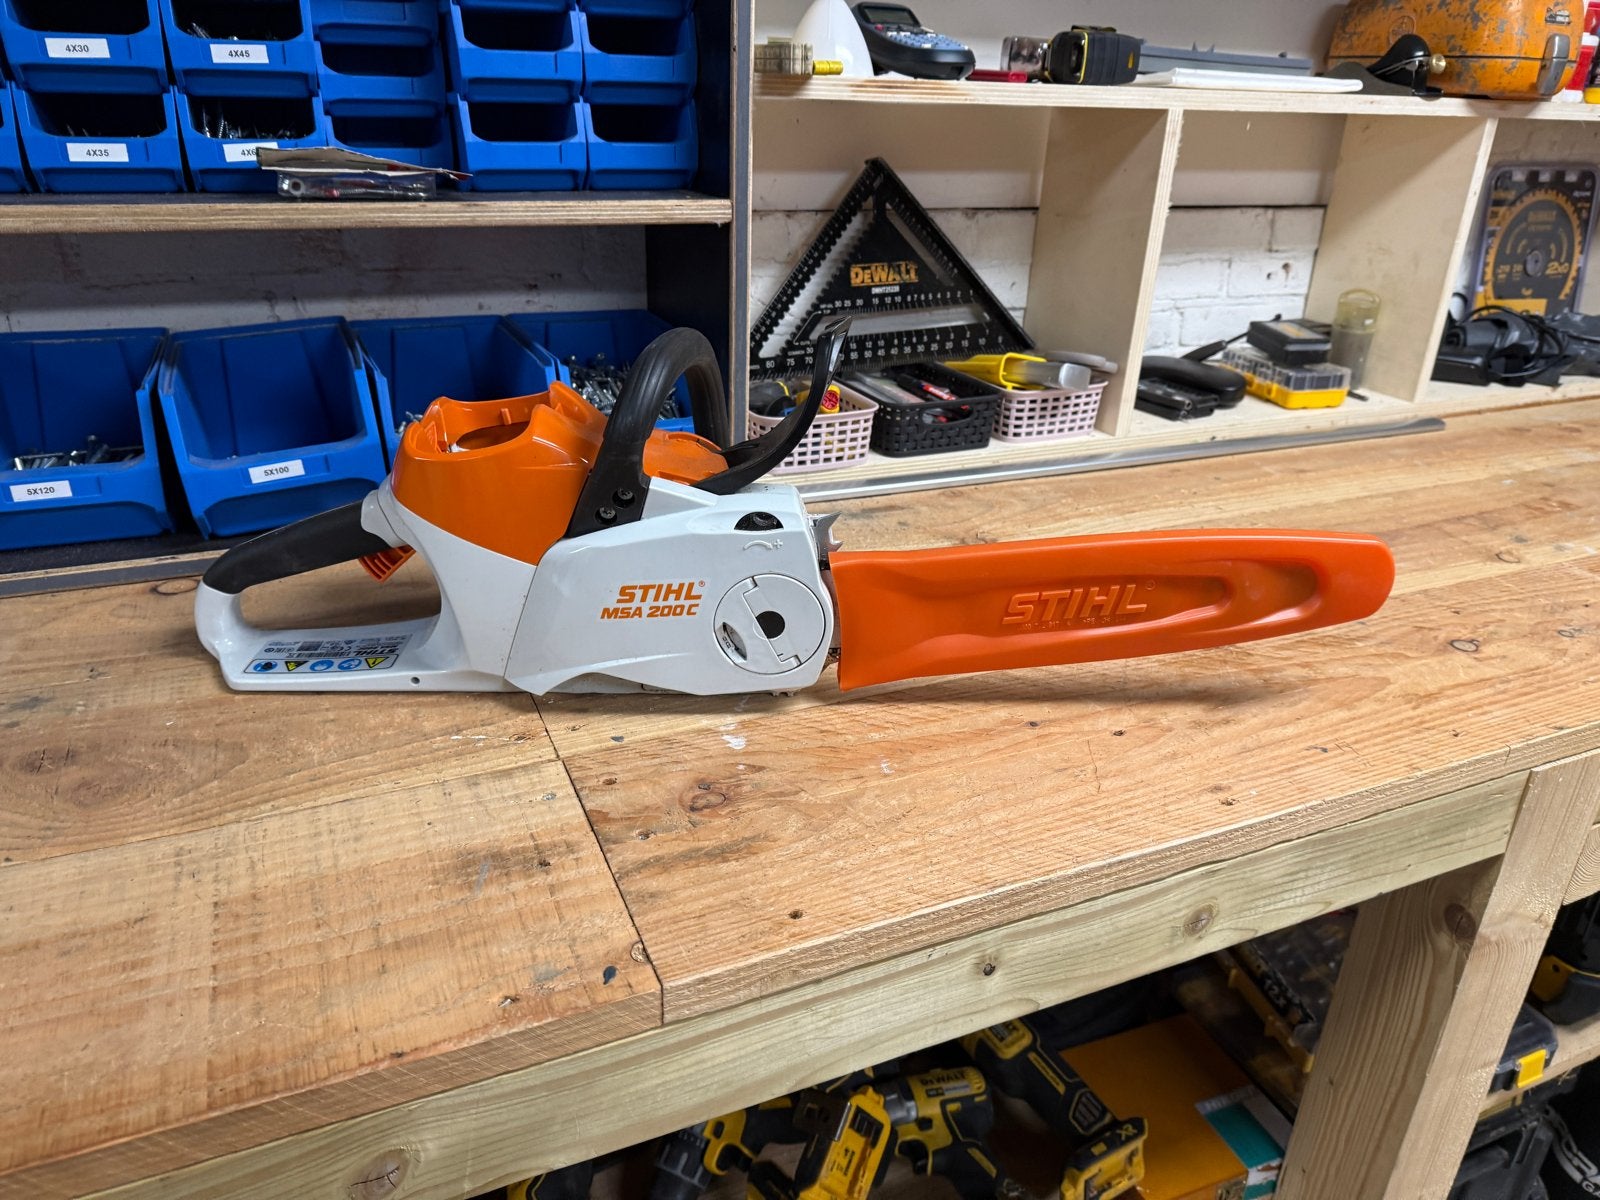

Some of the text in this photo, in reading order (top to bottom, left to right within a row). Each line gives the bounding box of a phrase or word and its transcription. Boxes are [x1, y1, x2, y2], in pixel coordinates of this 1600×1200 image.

[65, 44, 90, 53] 4X30
[228, 49, 251, 58] 4X45
[85, 148, 110, 157] 4X35
[240, 148, 257, 156] 4X6
[765, 360, 775, 369] 80
[786, 358, 796, 367] 75
[805, 356, 813, 365] 70
[877, 348, 886, 357] 45
[263, 466, 290, 477] 5X100
[26, 486, 55, 496] 5X120
[600, 606, 643, 619] MSA
